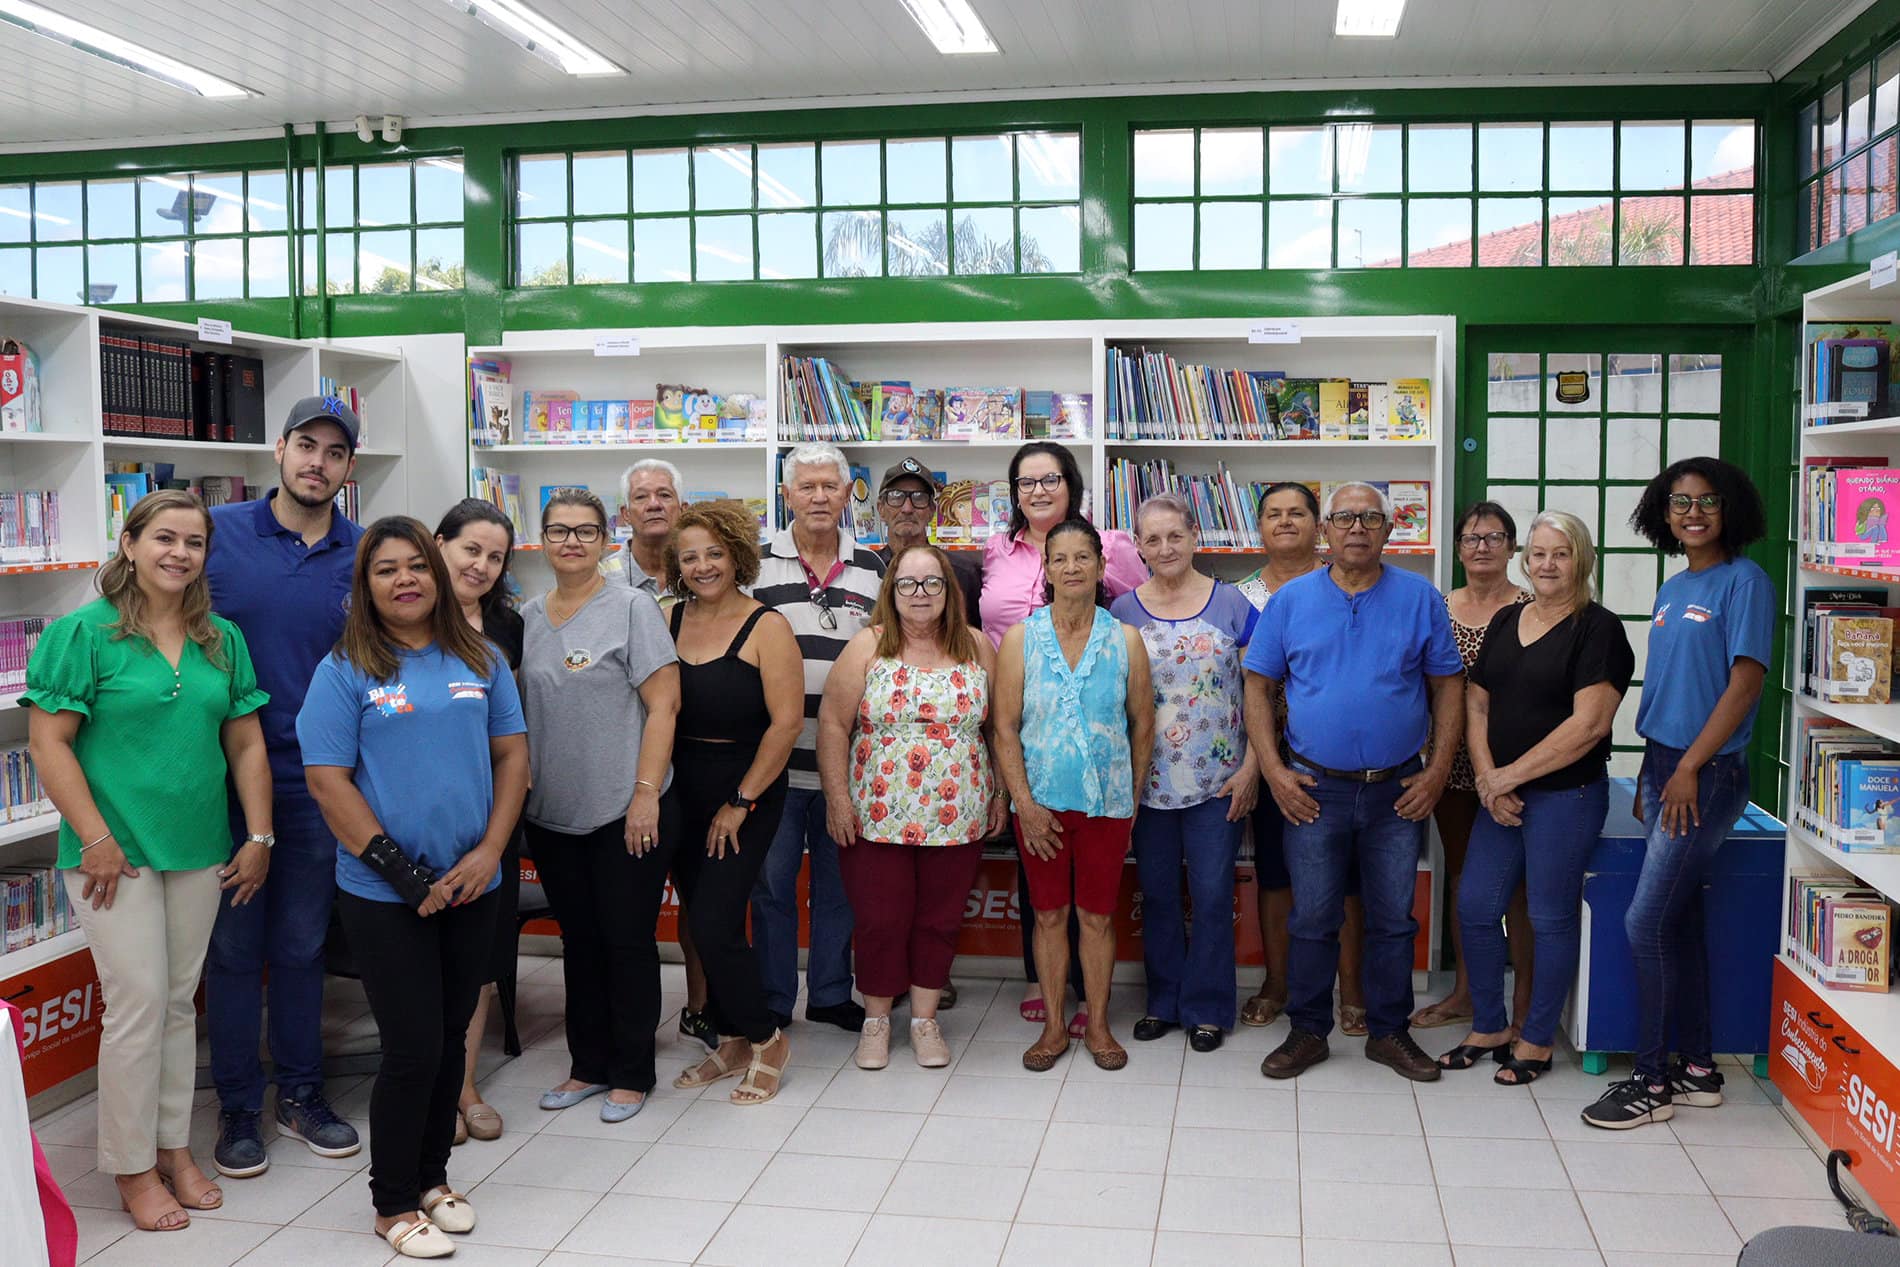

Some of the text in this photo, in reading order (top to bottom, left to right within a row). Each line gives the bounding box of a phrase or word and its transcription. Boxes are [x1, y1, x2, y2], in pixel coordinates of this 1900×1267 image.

[1859, 783, 1899, 792] MANUELA
[1868, 776, 1890, 784] DOCE
[1855, 913, 1886, 921] BANDEIRA
[1838, 948, 1879, 965] A DROGA
[22, 983, 93, 1049] SESI
[1783, 1000, 1797, 1023] SESI
[1819, 1036, 1827, 1053] do
[1846, 1073, 1897, 1153] SESI
